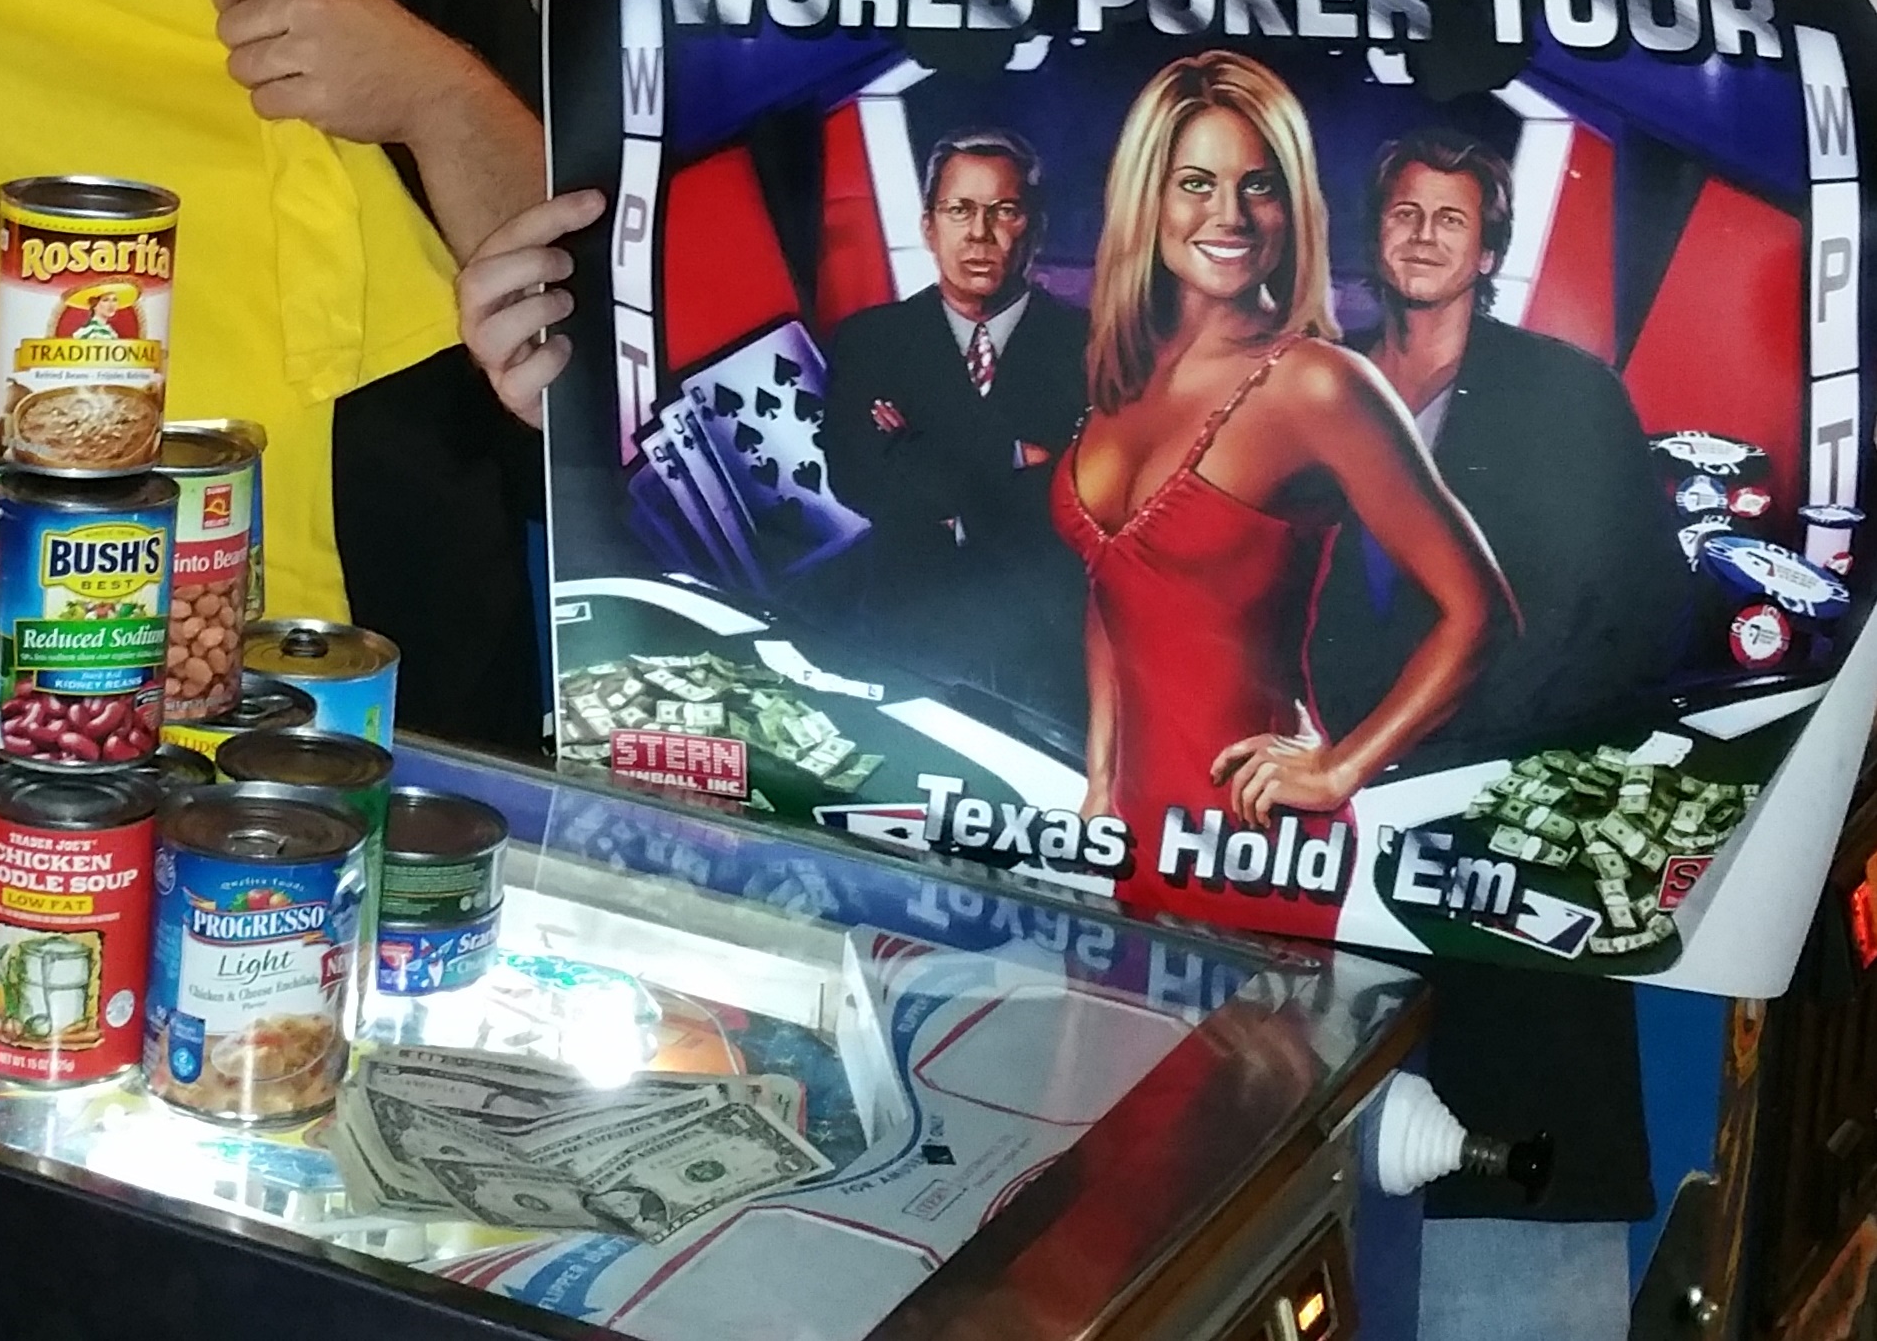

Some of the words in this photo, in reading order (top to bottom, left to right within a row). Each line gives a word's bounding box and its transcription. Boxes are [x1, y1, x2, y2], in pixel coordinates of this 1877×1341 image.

[21, 234, 170, 281] Rosarita
[29, 344, 156, 362] TRADITIONAL
[49, 537, 160, 577] BUSH'S
[173, 552, 210, 573] into
[81, 579, 134, 590] BEST
[23, 628, 105, 649] Reduced
[111, 624, 165, 648] Sodium
[54, 679, 102, 689] KIDNEY
[105, 676, 143, 688] BEANS
[616, 733, 741, 777] STERN
[9, 832, 53, 850] TRADER
[918, 772, 1128, 866] Texas
[1158, 808, 1347, 894] Hold
[1375, 824, 1518, 913] 'Em
[69, 869, 139, 893] SOUP
[6, 891, 45, 909] LOW
[50, 900, 87, 911] FAT
[192, 906, 324, 939] PROGRESSO
[217, 949, 296, 986] Light
